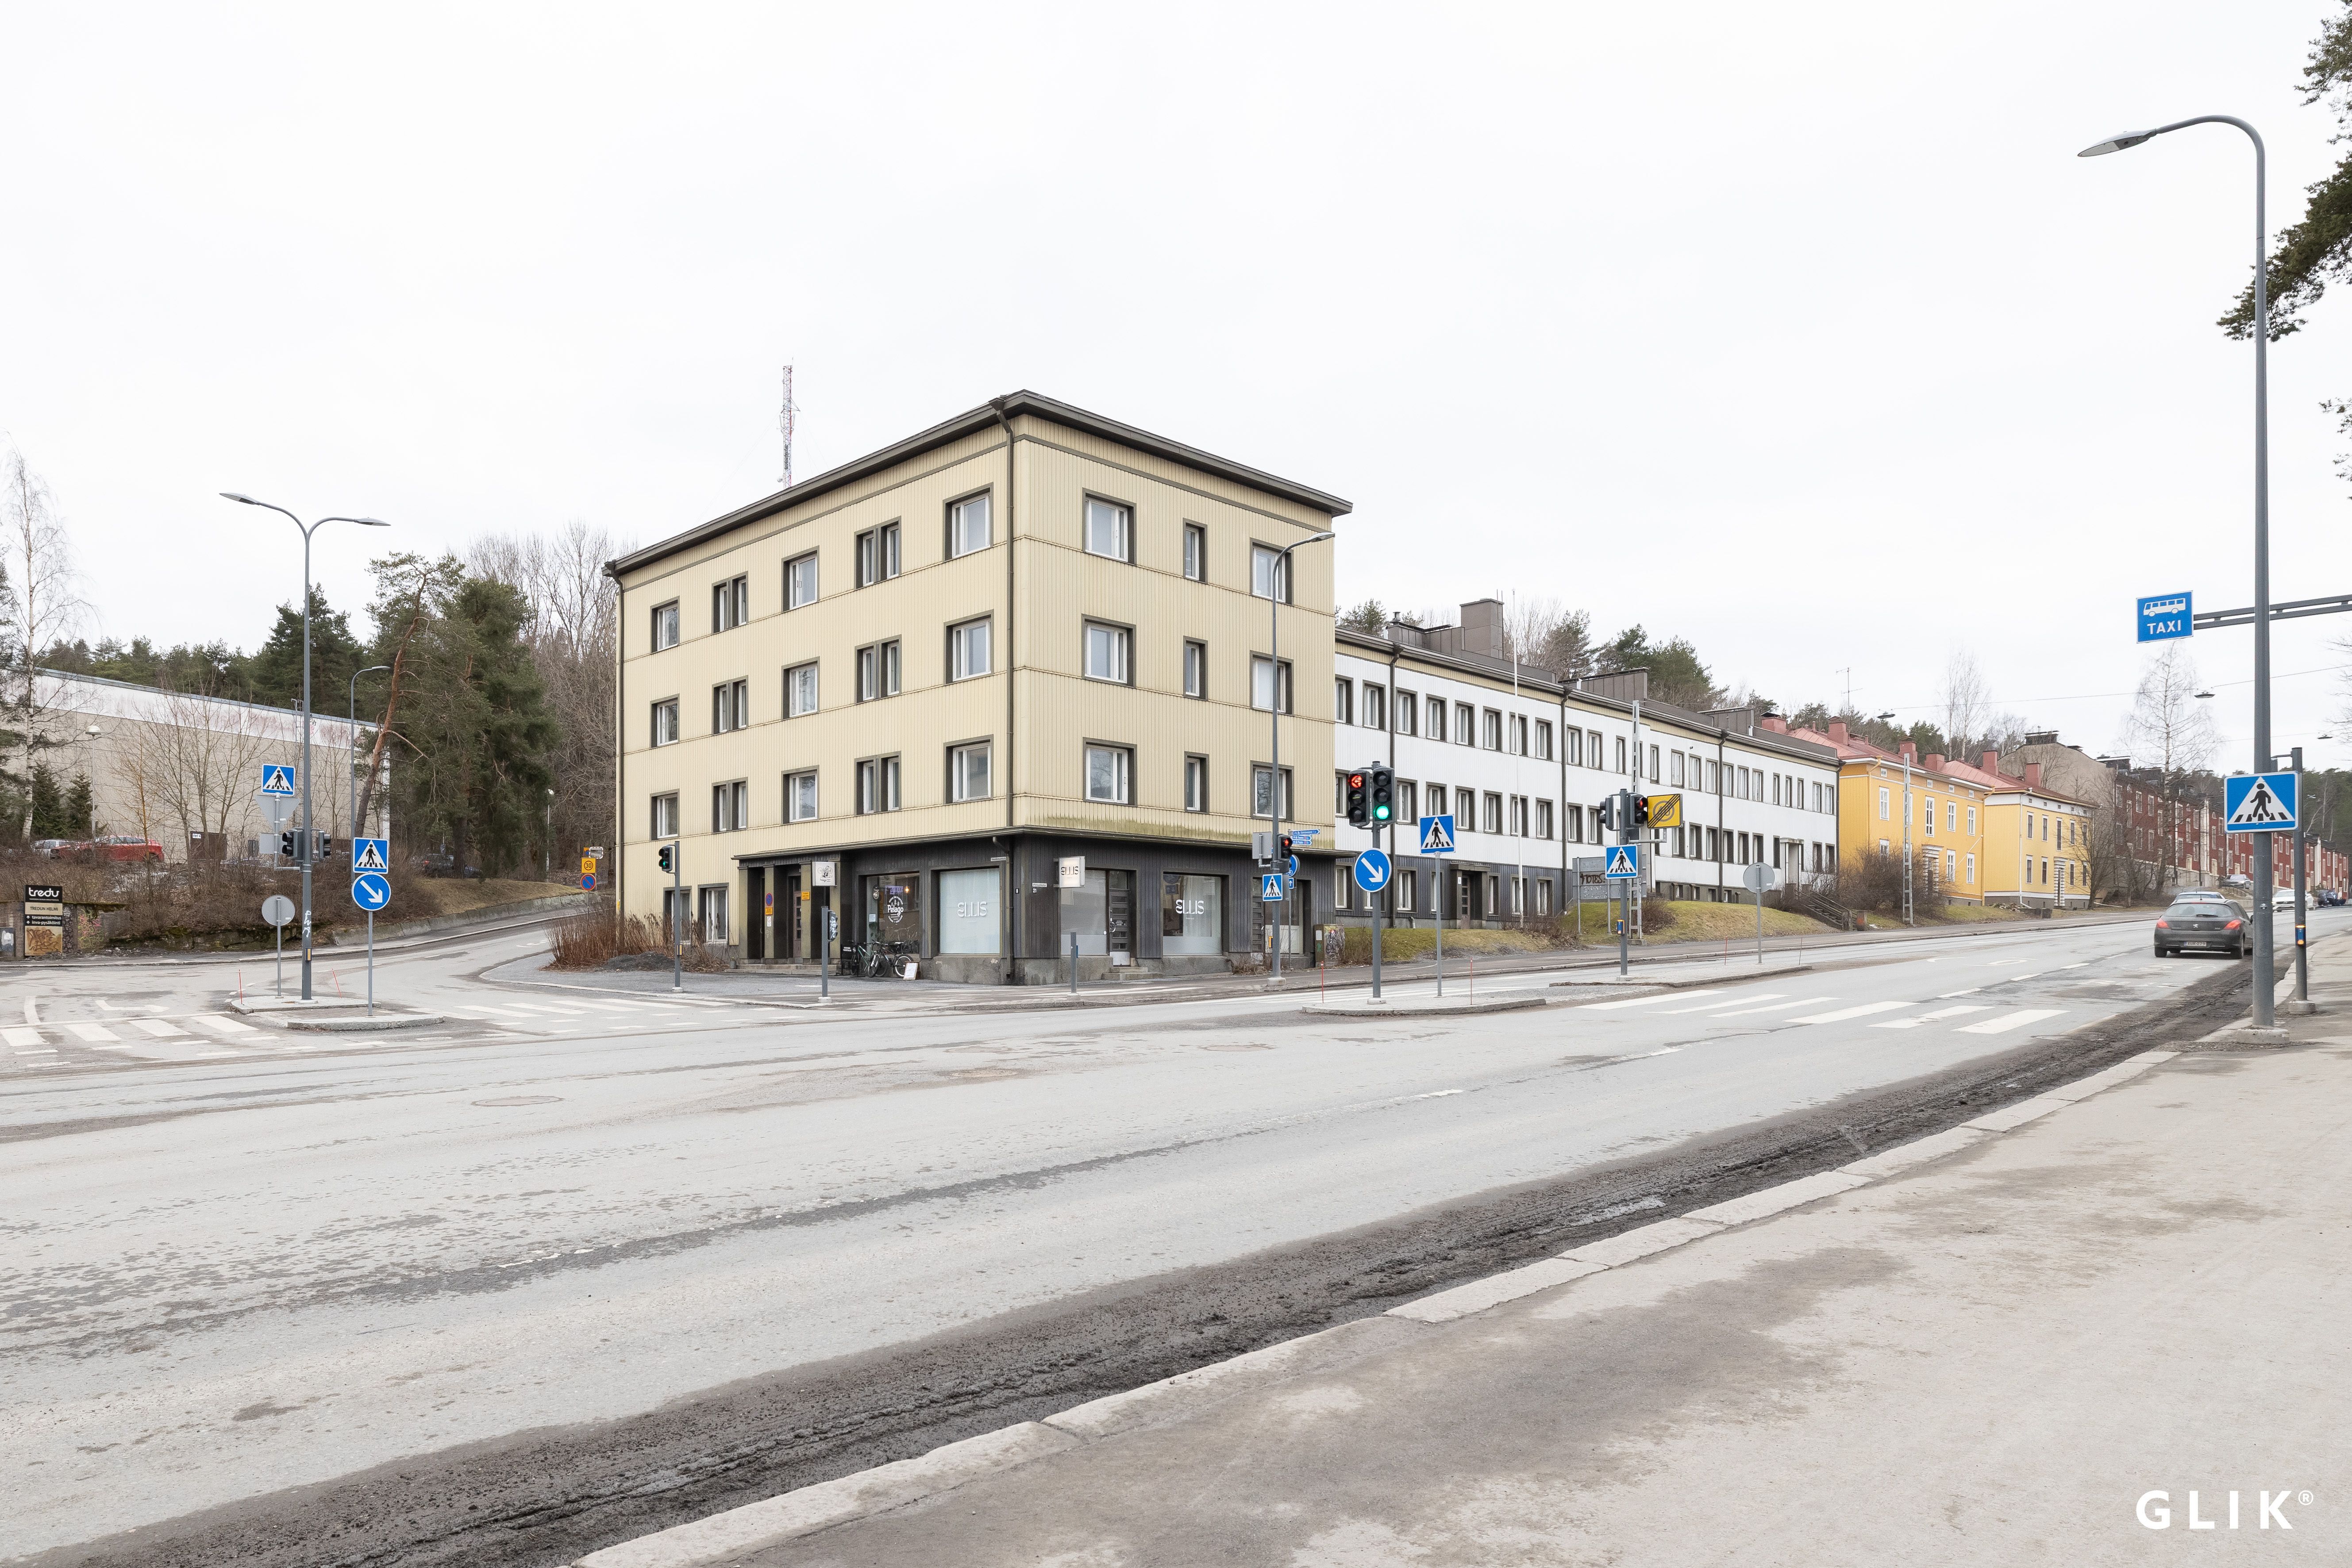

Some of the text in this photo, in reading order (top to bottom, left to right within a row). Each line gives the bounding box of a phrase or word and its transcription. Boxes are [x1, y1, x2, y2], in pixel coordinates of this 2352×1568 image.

[2147, 620, 2181, 634] TAXI
[1061, 866, 1079, 875] ELLIS
[29, 887, 60, 897] tredu
[887, 905, 904, 916] Pelago
[957, 901, 987, 917] ELLIS
[1175, 899, 1205, 915] ELLIS
